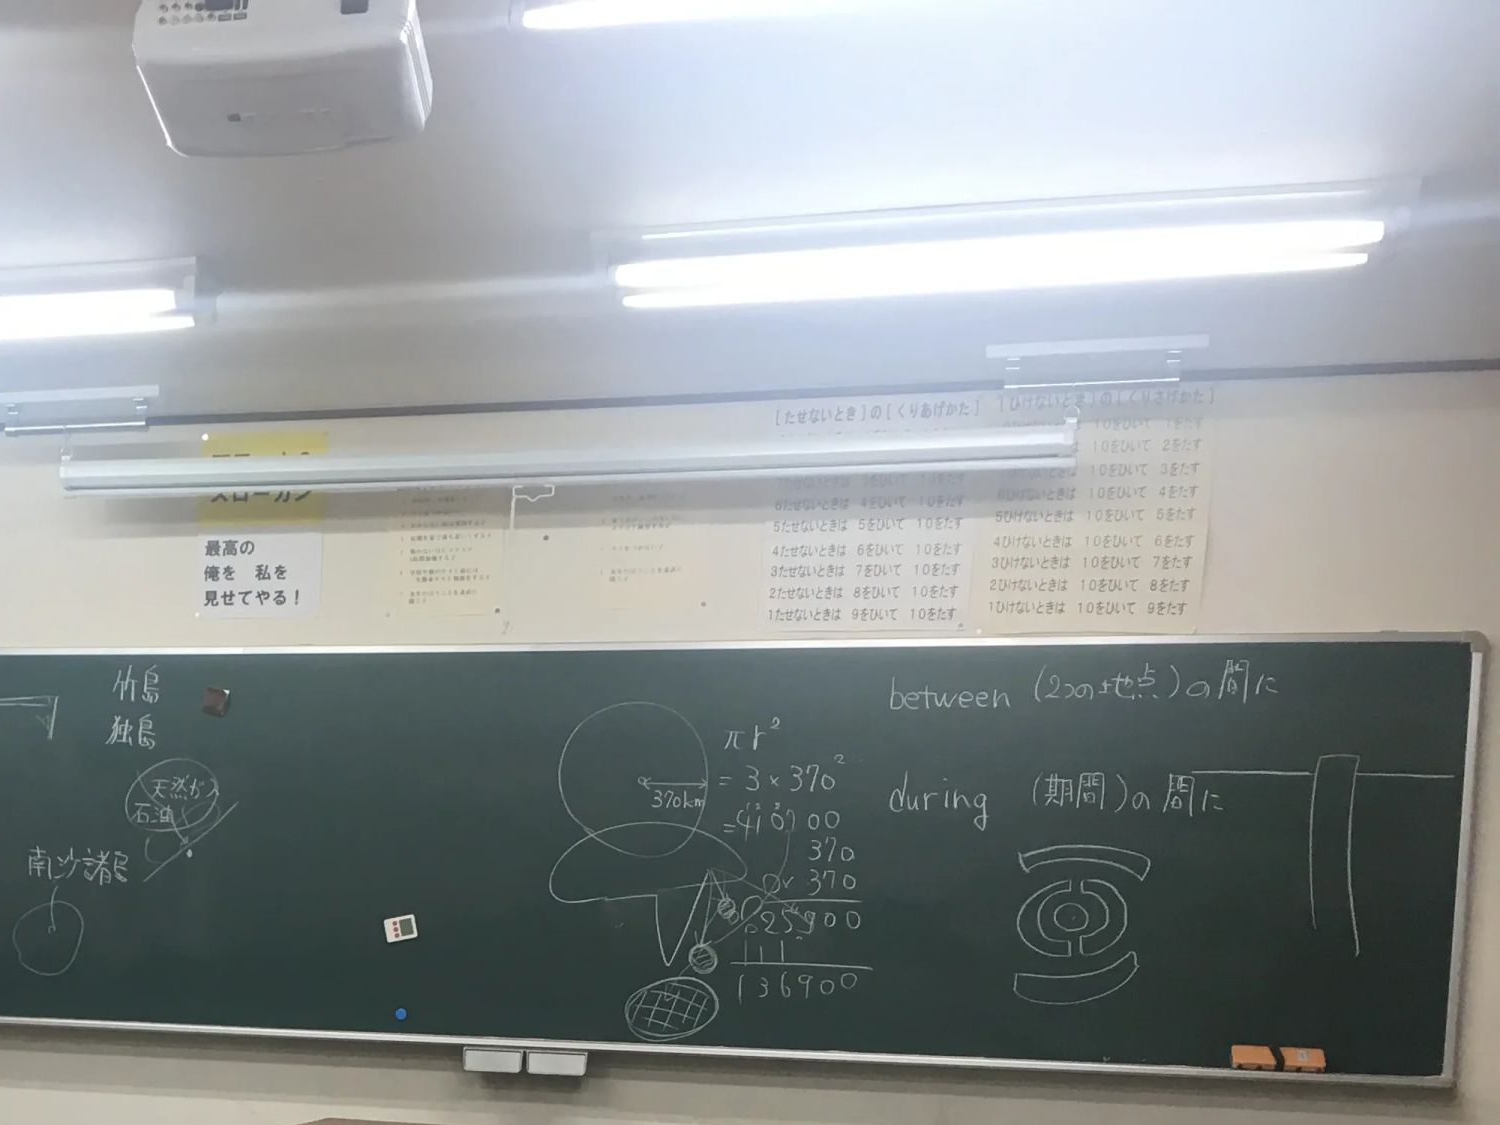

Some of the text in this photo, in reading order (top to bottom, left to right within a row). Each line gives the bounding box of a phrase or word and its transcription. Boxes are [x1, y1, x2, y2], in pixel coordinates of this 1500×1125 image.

[1093, 438, 1203, 453] 10をひいて 2をたす
[1091, 463, 1148, 477] 10をひいて
[1160, 463, 1201, 476] 3をたす
[1090, 486, 1147, 499] 10をひいて
[1159, 485, 1199, 499] 4をたす
[996, 508, 1197, 523] 5ひけないときは 10をひいて 5をたす
[774, 517, 964, 533] 5たせないときは 5をひいて 10をたす
[205, 540, 255, 556] 最高の
[993, 534, 1195, 549] 4ひけないときは 10をひいて 6をたす
[772, 542, 962, 558] 4たせないときは 6をひいて 10をたす
[771, 563, 961, 578] 3たせないときは 7をひいて 10をたす
[991, 555, 1193, 570] 3ひけないときは 10をひいて 7をたす
[204, 564, 288, 581] 俺を 私を
[769, 585, 959, 600] 2たせないときは 8をひいて 10をたす
[989, 578, 1190, 592] 2ひけないときは 10をひいて 8をたす
[204, 589, 300, 607] 見せてやる！
[768, 607, 956, 621] 1たせないときは 9をひいて 10をたす
[989, 601, 1188, 615] 1ひけないときは 10をひいて 9をたす
[112, 665, 159, 704] 竹島
[890, 677, 1011, 711] between
[105, 714, 156, 750] 独島
[889, 771, 988, 831] during
[132, 802, 174, 823] 石油
[808, 837, 855, 862] 370
[807, 869, 856, 895] 370
[738, 971, 858, 1004] 136900
